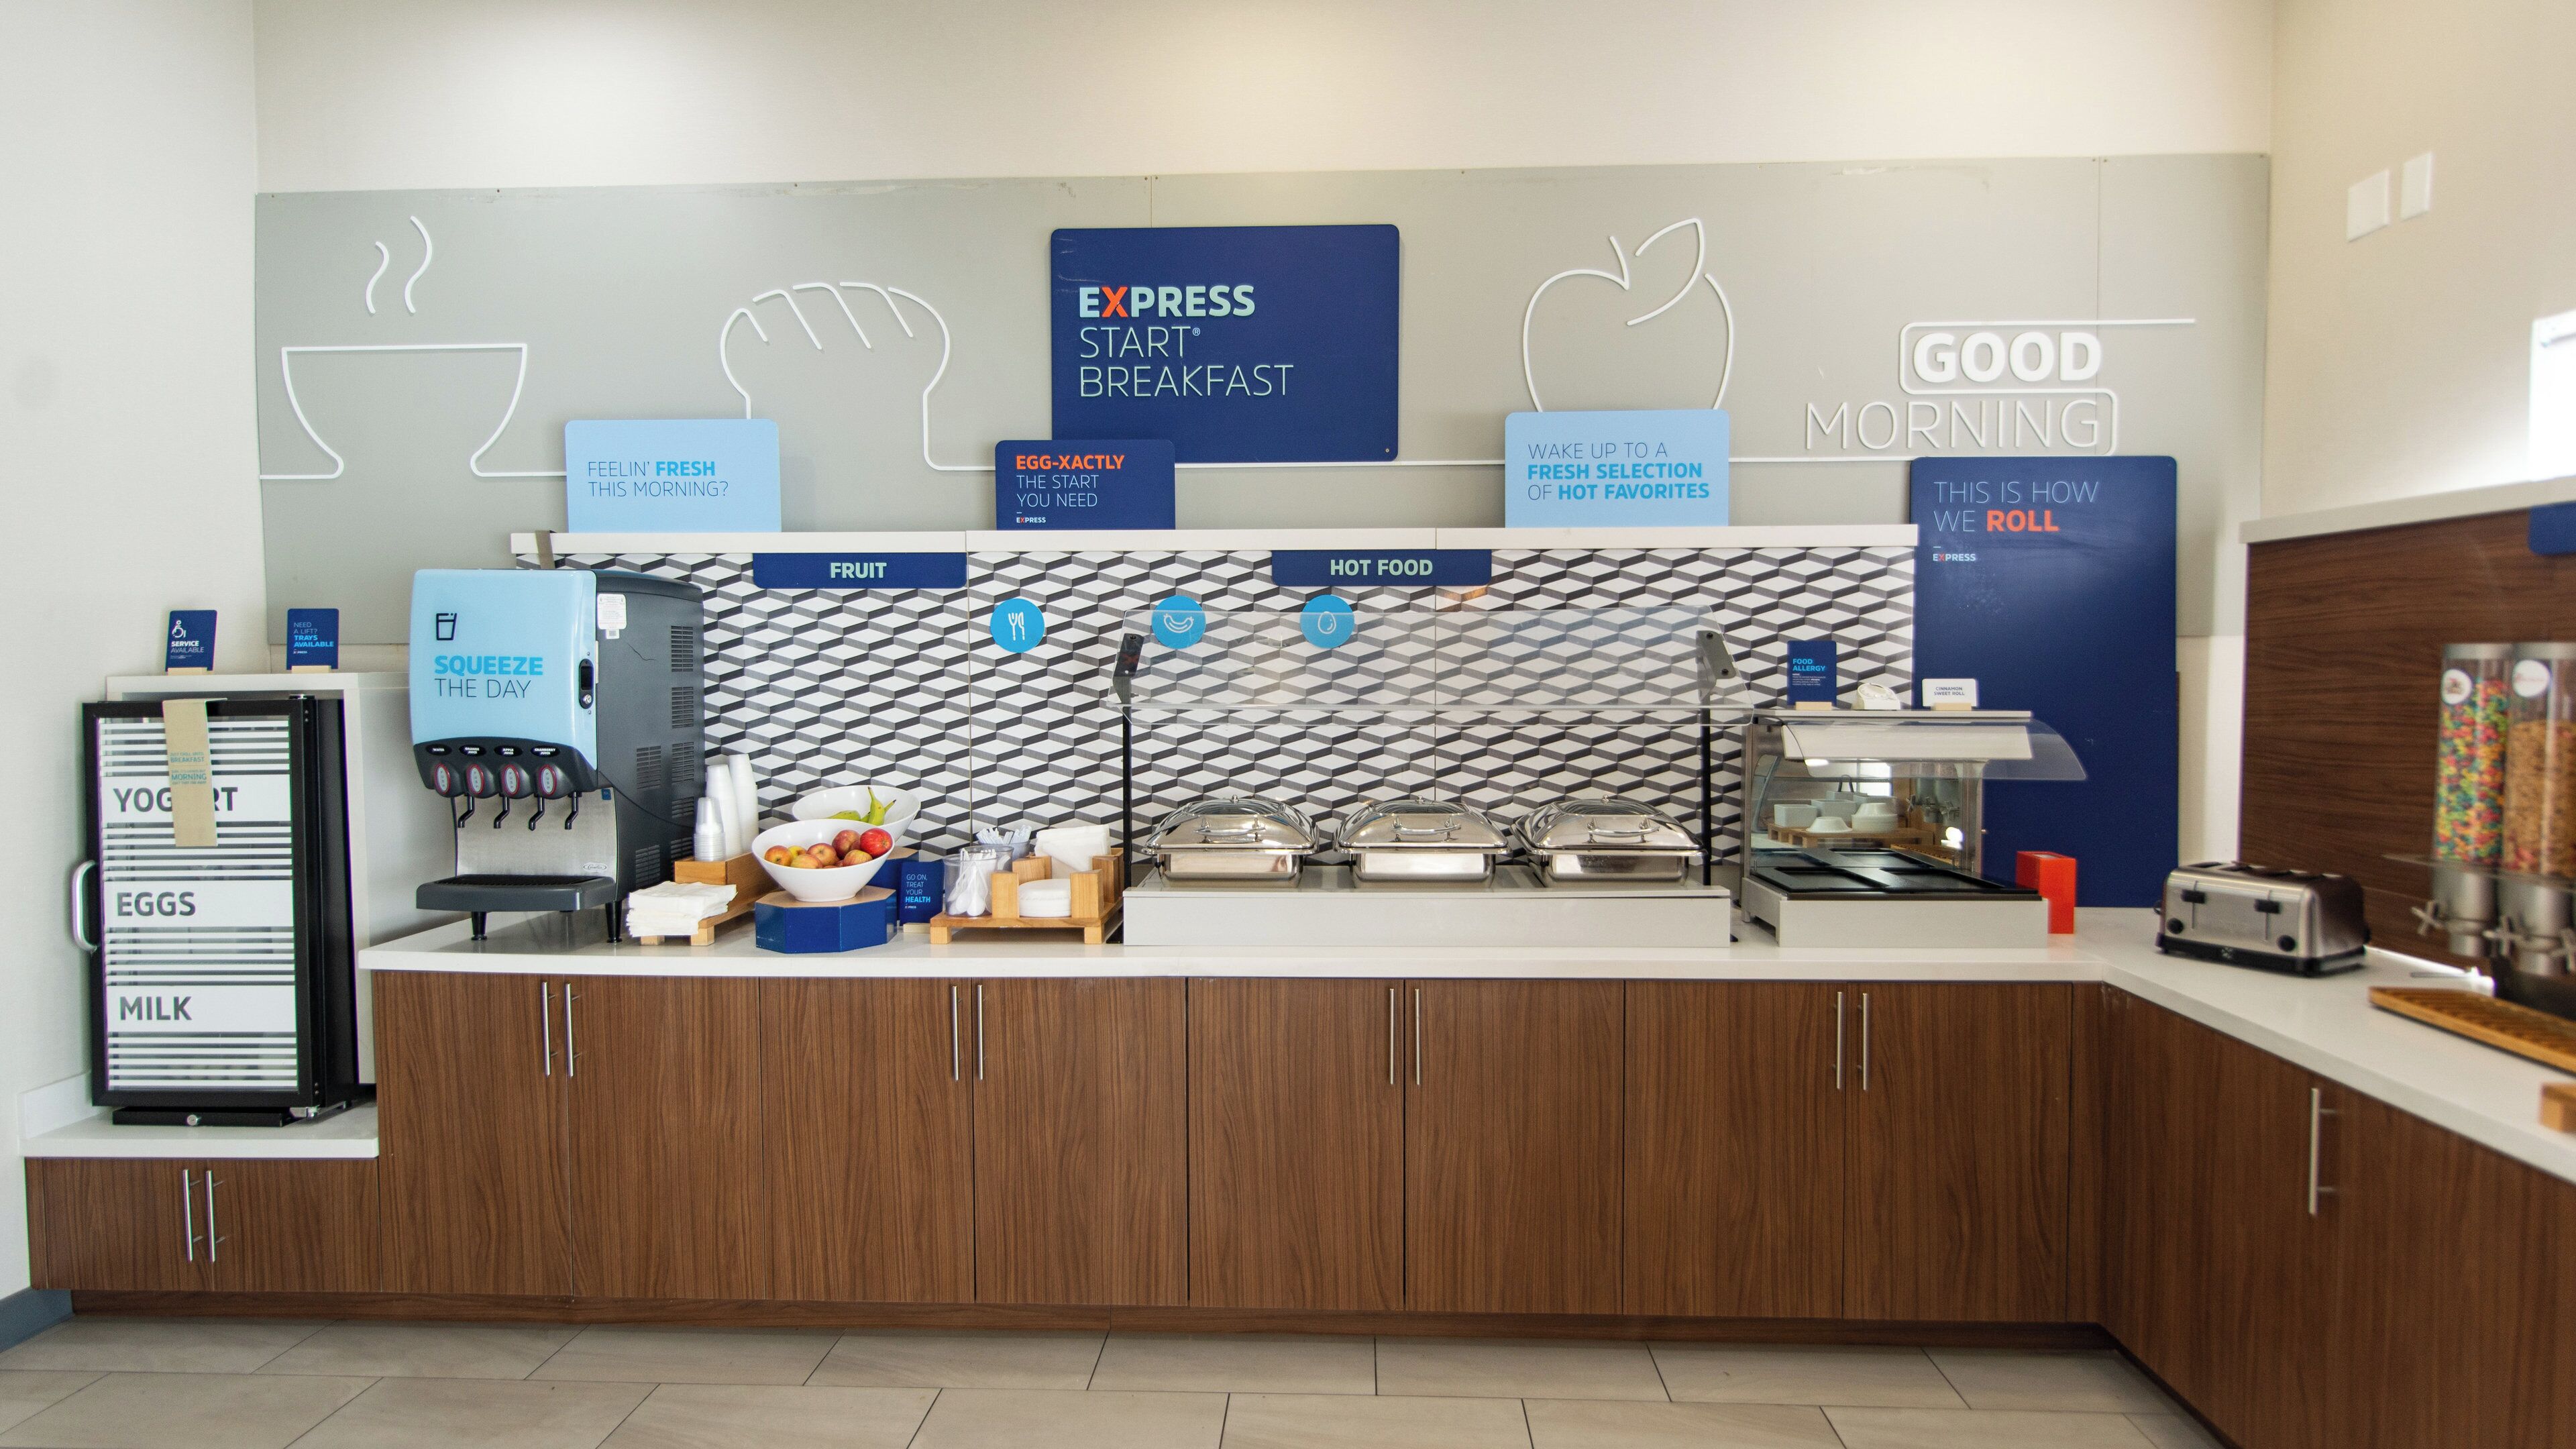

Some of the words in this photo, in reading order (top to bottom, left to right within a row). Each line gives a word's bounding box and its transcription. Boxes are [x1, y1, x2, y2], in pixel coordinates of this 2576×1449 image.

[1079, 284, 1256, 318] EXPRESS
[1913, 331, 2103, 384] GOOD
[1080, 364, 1295, 397] BREAKFAST
[1805, 399, 2099, 450] MORNING
[1527, 443, 1584, 460] WAKE
[1591, 442, 1617, 459] UP
[1623, 441, 1648, 459] TO
[1654, 441, 1668, 458] A
[655, 460, 716, 477] FRESH
[1016, 454, 1126, 470] EGG-XACTLY
[1527, 464, 1590, 480] FRESH
[1596, 462, 1703, 480] SELECTION
[588, 481, 628, 497] THIS
[633, 480, 729, 497] MORNING?
[1016, 474, 1046, 489] THE
[1052, 474, 1099, 489] START
[1016, 492, 1051, 508] YOU
[1056, 492, 1098, 507] NEED
[1527, 484, 1552, 501] OF
[1558, 484, 1598, 500] HOT
[1604, 482, 1710, 500] FAVORITES
[1933, 481, 1990, 504] THIS
[2000, 481, 2021, 504] IS
[2031, 480, 2099, 503] HOW
[1933, 510, 1976, 532] WE
[1986, 509, 2060, 532] ROLL
[1932, 553, 1976, 561] EXPRESS
[830, 562, 888, 579] FRUIT
[1330, 559, 1372, 576] HOT
[1377, 559, 1434, 576] FOOD
[434, 655, 543, 677] SQUEEZE
[434, 678, 477, 698] THE
[486, 679, 532, 698] DAY
[113, 786, 239, 812] YOGT
[116, 891, 197, 917] EGGS
[119, 996, 193, 1021] MILK
